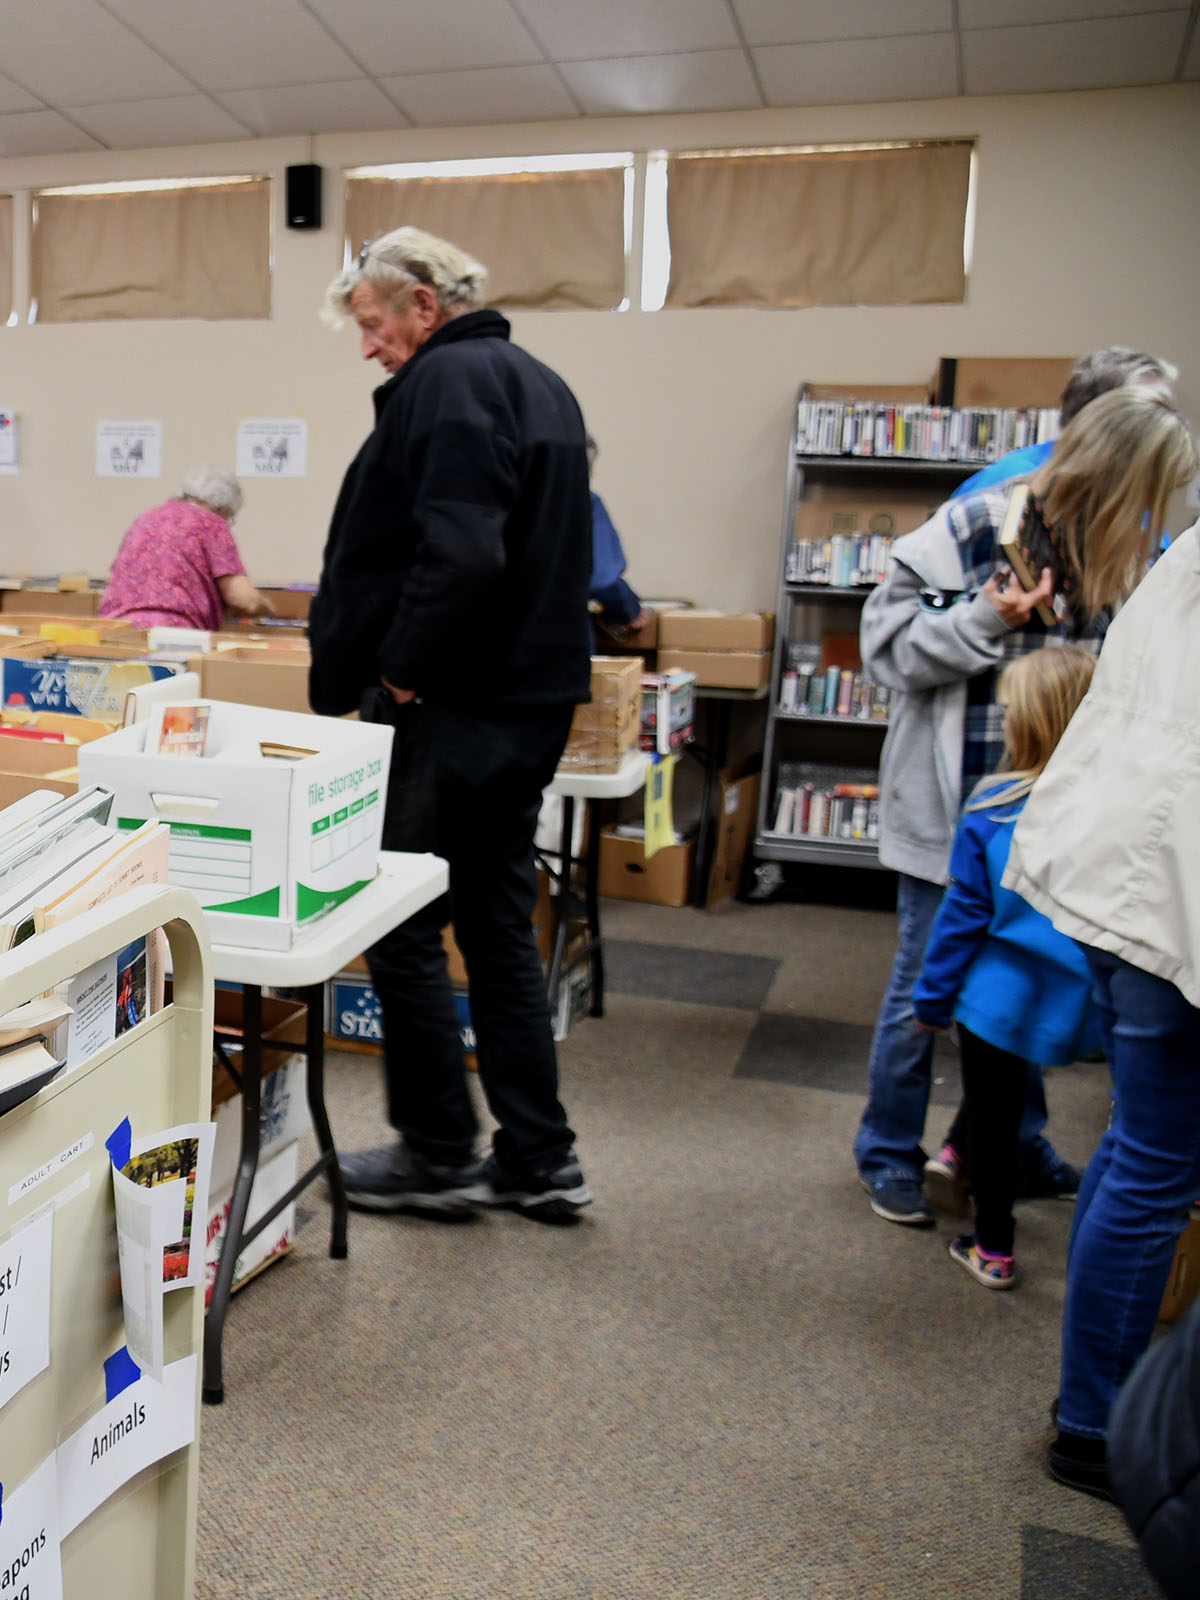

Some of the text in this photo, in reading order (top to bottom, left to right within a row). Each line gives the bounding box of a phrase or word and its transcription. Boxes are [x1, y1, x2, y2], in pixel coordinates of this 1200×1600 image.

[308, 758, 382, 806] file storage box
[20, 1141, 84, 1191] ADULT CART
[90, 1402, 146, 1466] Animals
